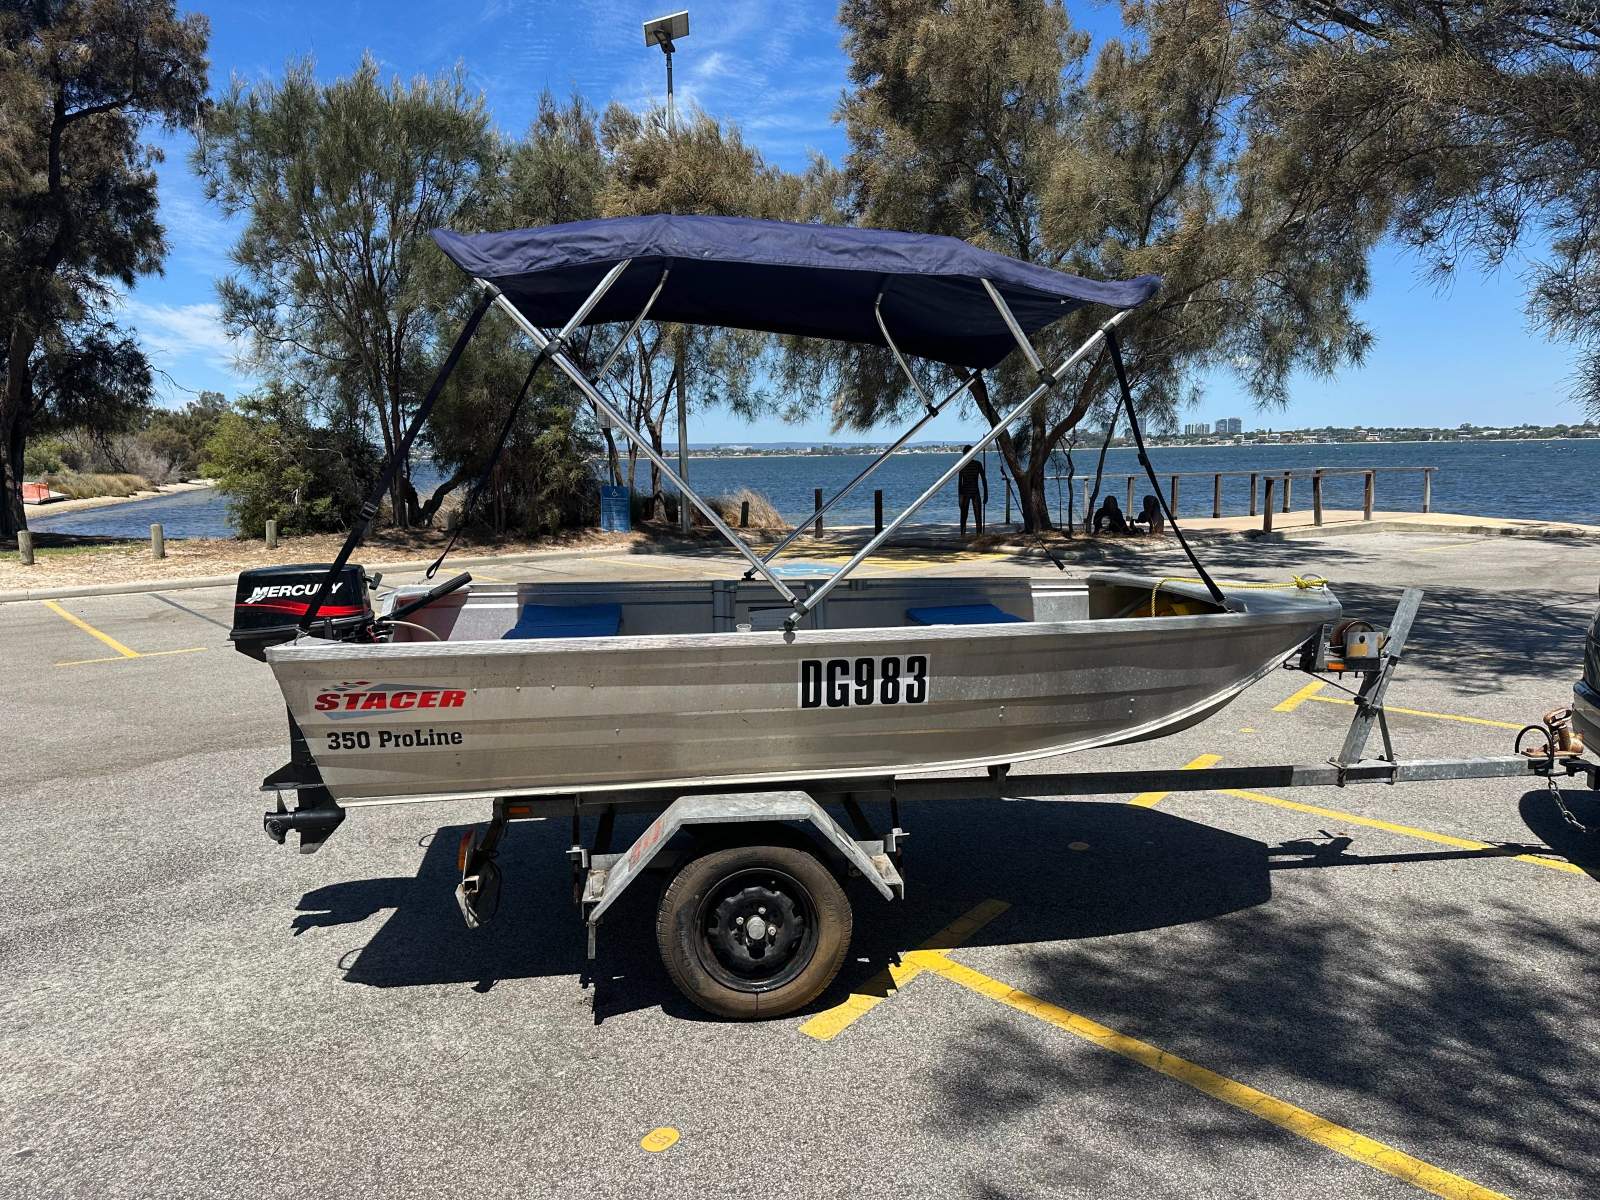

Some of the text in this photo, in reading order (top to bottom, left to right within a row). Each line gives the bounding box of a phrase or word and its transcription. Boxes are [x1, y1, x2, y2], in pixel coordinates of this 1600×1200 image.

[246, 582, 343, 603] MERCUY
[801, 656, 927, 708] DG983
[314, 690, 467, 711] STACER
[326, 729, 463, 750] 350 ProLine
